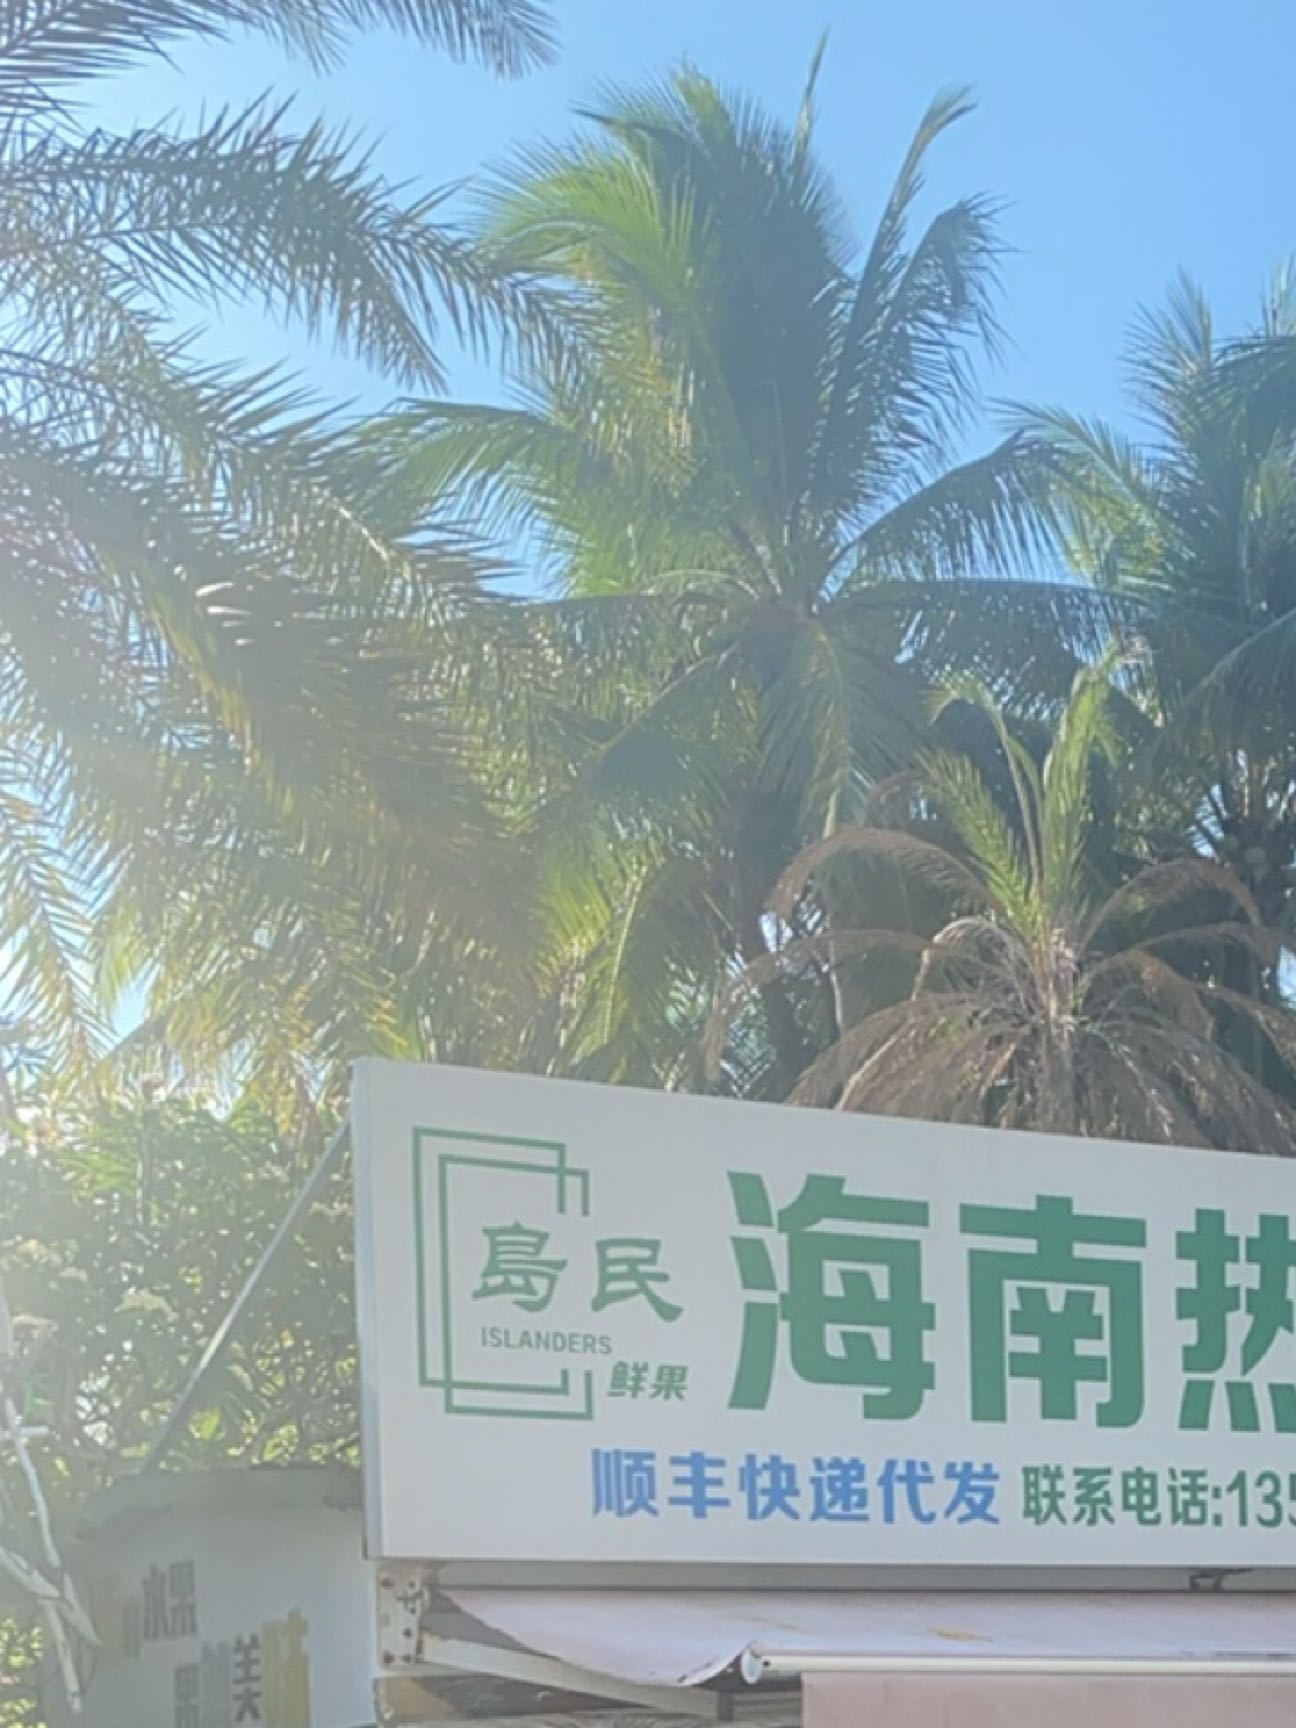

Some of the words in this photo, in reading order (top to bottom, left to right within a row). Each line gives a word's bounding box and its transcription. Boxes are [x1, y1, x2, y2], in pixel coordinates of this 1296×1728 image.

[472, 1221, 684, 1323] 島民
[480, 1325, 613, 1355] ISLANDERS
[606, 1361, 689, 1402] 鲜果
[591, 1448, 1001, 1526] 顺丰快递代发
